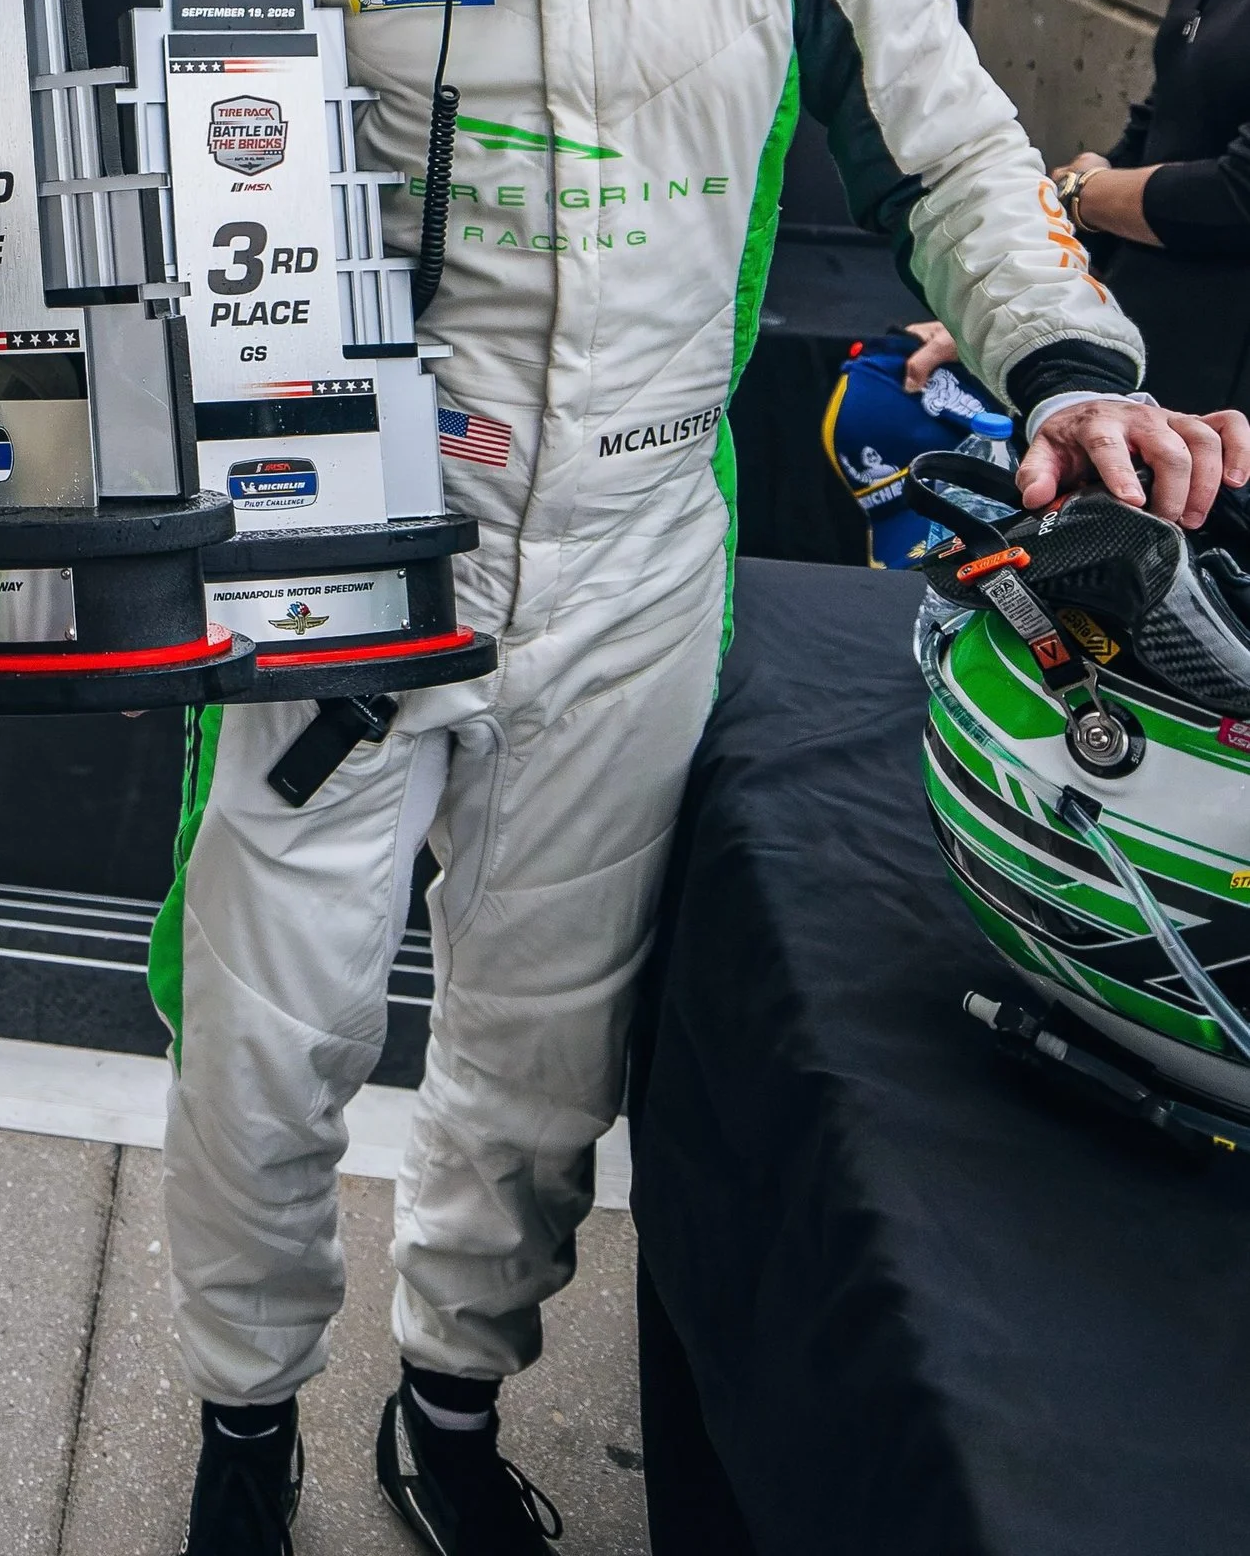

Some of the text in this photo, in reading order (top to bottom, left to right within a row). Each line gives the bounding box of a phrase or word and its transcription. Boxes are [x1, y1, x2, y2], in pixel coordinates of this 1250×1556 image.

[181, 7, 296, 18] SEPTEMBER 19, 2026
[218, 107, 275, 120] TIRE RACK
[212, 125, 283, 138] BATTLE ON
[212, 138, 282, 150] THE BRICKS
[244, 183, 272, 192] IMSA
[463, 225, 647, 252] RACING
[207, 221, 319, 296] 3RD
[210, 299, 310, 327] PLACE
[240, 345, 268, 362] GS
[265, 462, 291, 472] IMSA
[258, 481, 306, 492] MICHELIN
[244, 498, 305, 508] PILOT CHALLENGE
[1038, 510, 1058, 535] PRO
[213, 582, 375, 602] INDIANAPOLIS MOTOR SPEEDWAY
